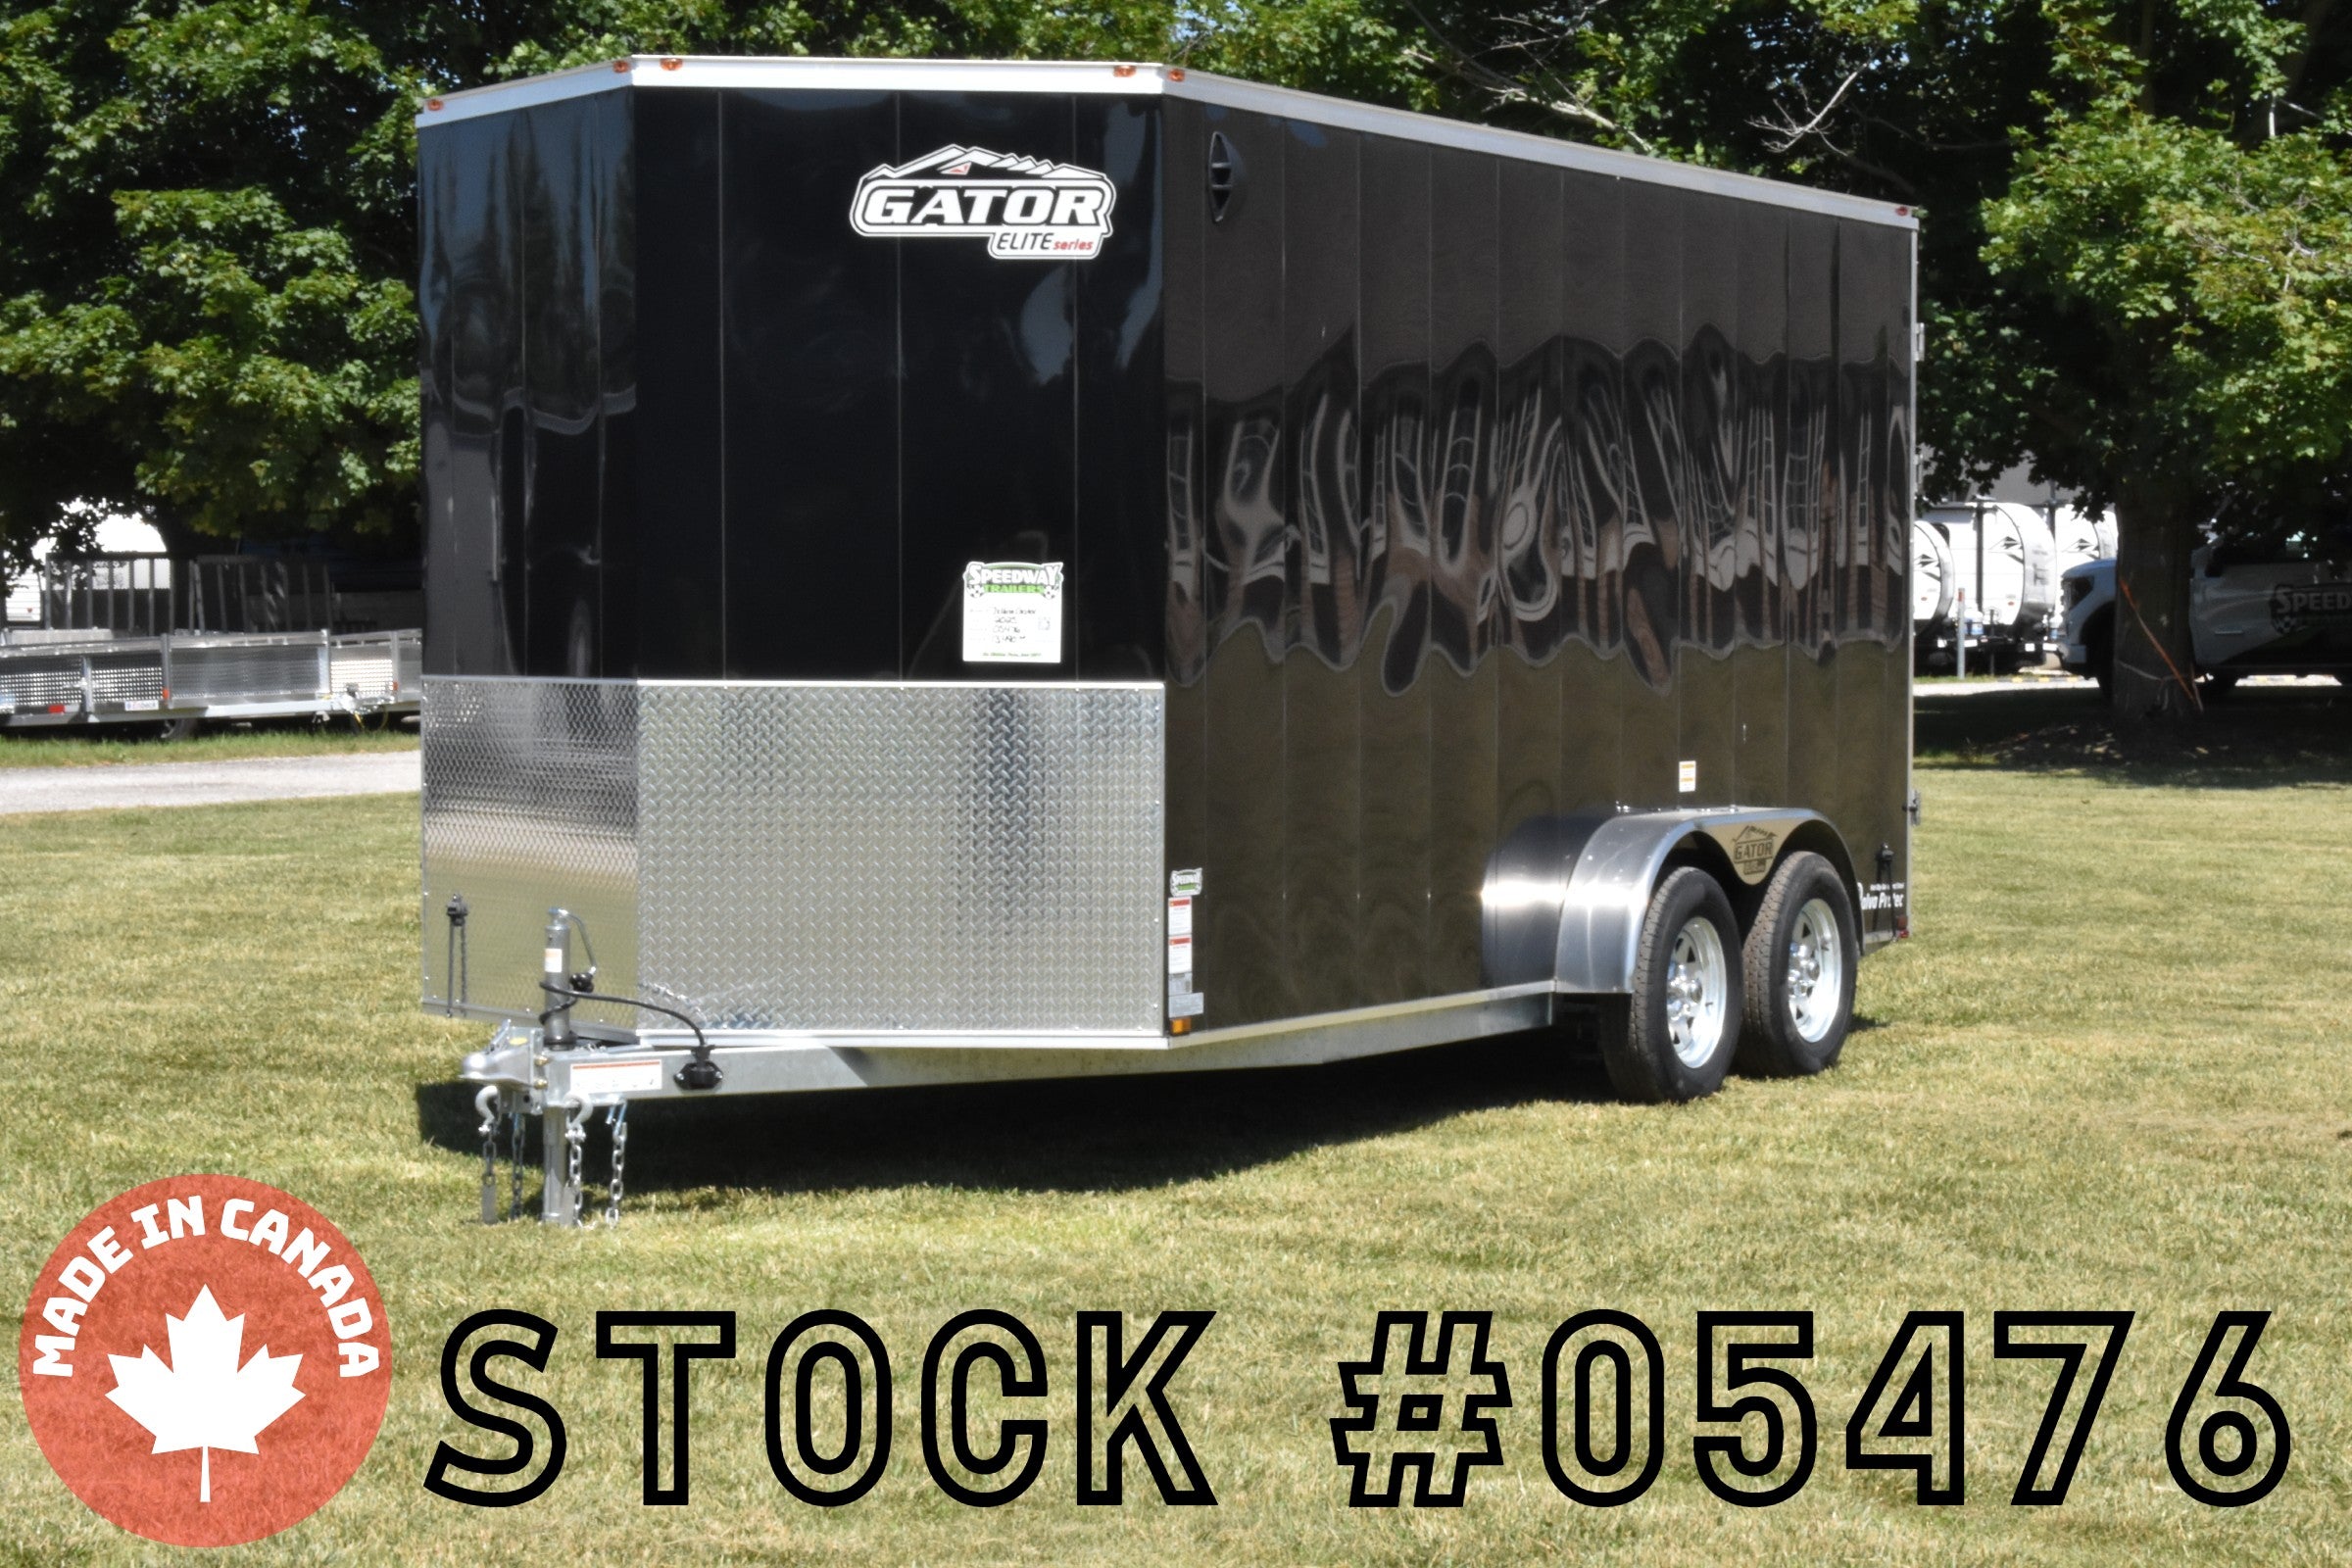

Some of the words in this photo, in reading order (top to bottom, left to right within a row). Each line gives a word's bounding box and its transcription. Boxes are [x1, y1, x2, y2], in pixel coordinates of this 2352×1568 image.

[862, 187, 1104, 225] GATOR
[996, 232, 1054, 251] ELITE
[1053, 238, 1094, 251] series
[968, 564, 1060, 586] SPEEDWAY
[984, 584, 1045, 594] TRAILERS
[2276, 587, 2352, 614] SPEED
[1735, 842, 1774, 860] GATOR
